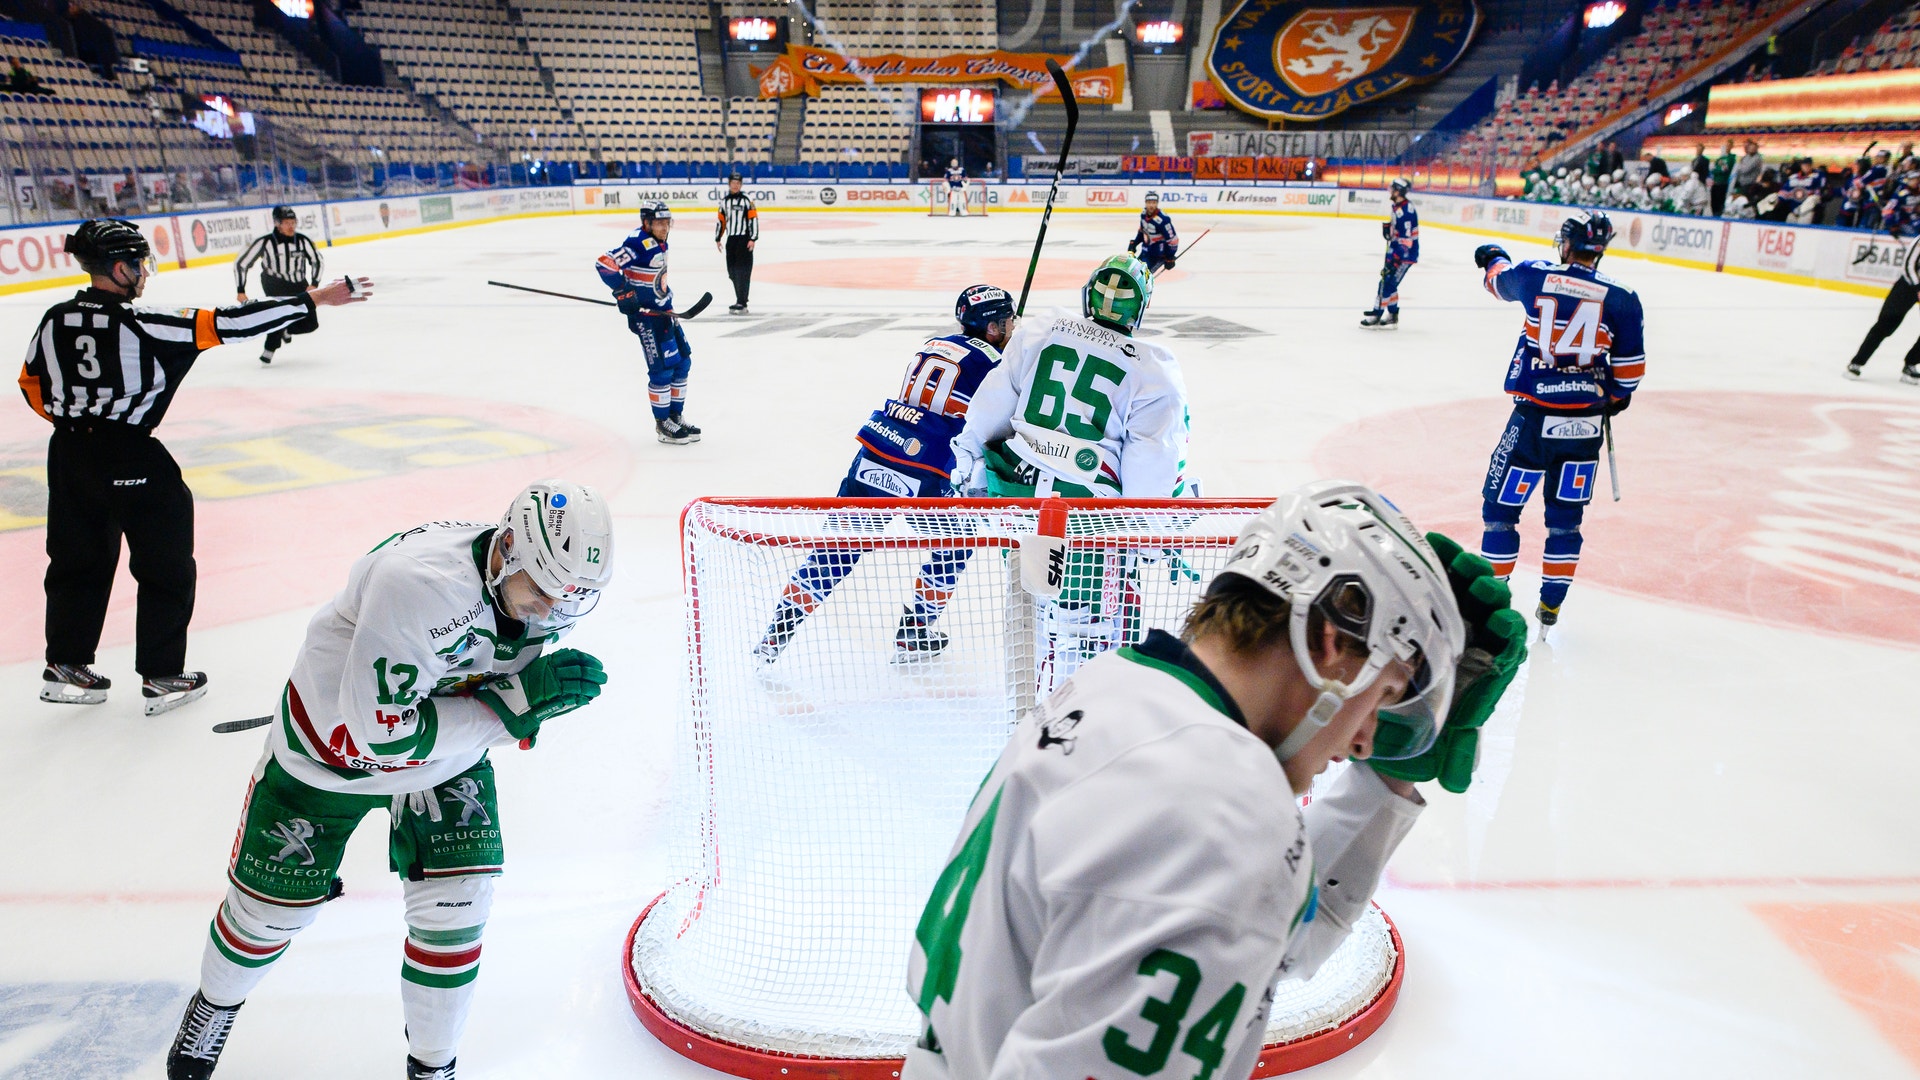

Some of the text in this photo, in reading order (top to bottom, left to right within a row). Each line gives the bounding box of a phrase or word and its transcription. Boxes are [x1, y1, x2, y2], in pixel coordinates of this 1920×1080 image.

[737, 18, 770, 40] MÅL
[1220, 61, 1290, 106] STORT
[933, 88, 984, 122] MÅL
[847, 190, 909, 201] BORGA
[1087, 191, 1125, 203] JULA
[1227, 190, 1277, 204] Karlsson
[1283, 193, 1336, 205] SUBWAY
[1651, 218, 1713, 251] dynacon
[1757, 228, 1796, 257] VEAB
[77, 301, 104, 309] CCM
[1534, 296, 1605, 368] 14
[75, 335, 102, 379] 3
[1024, 343, 1127, 442] 65
[1536, 380, 1596, 394] Sundström
[887, 401, 925, 425] YNGE
[1490, 425, 1519, 490] WELLNESS
[113, 477, 147, 486] CCM
[547, 509, 557, 529] Bank
[555, 509, 566, 537] Resurs
[586, 546, 601, 564] 12
[1048, 544, 1066, 590] SHL
[1262, 570, 1293, 595] SHL
[428, 600, 485, 640] Backahill
[496, 643, 513, 654] SHL
[373, 657, 420, 706] 12
[431, 829, 500, 844] PEUGEOT
[433, 843, 471, 854] MOTOR
[242, 864, 328, 886] MOTOR VILLAGE
[244, 853, 332, 877] PEUGEOT
[1102, 948, 1247, 1080] 34
